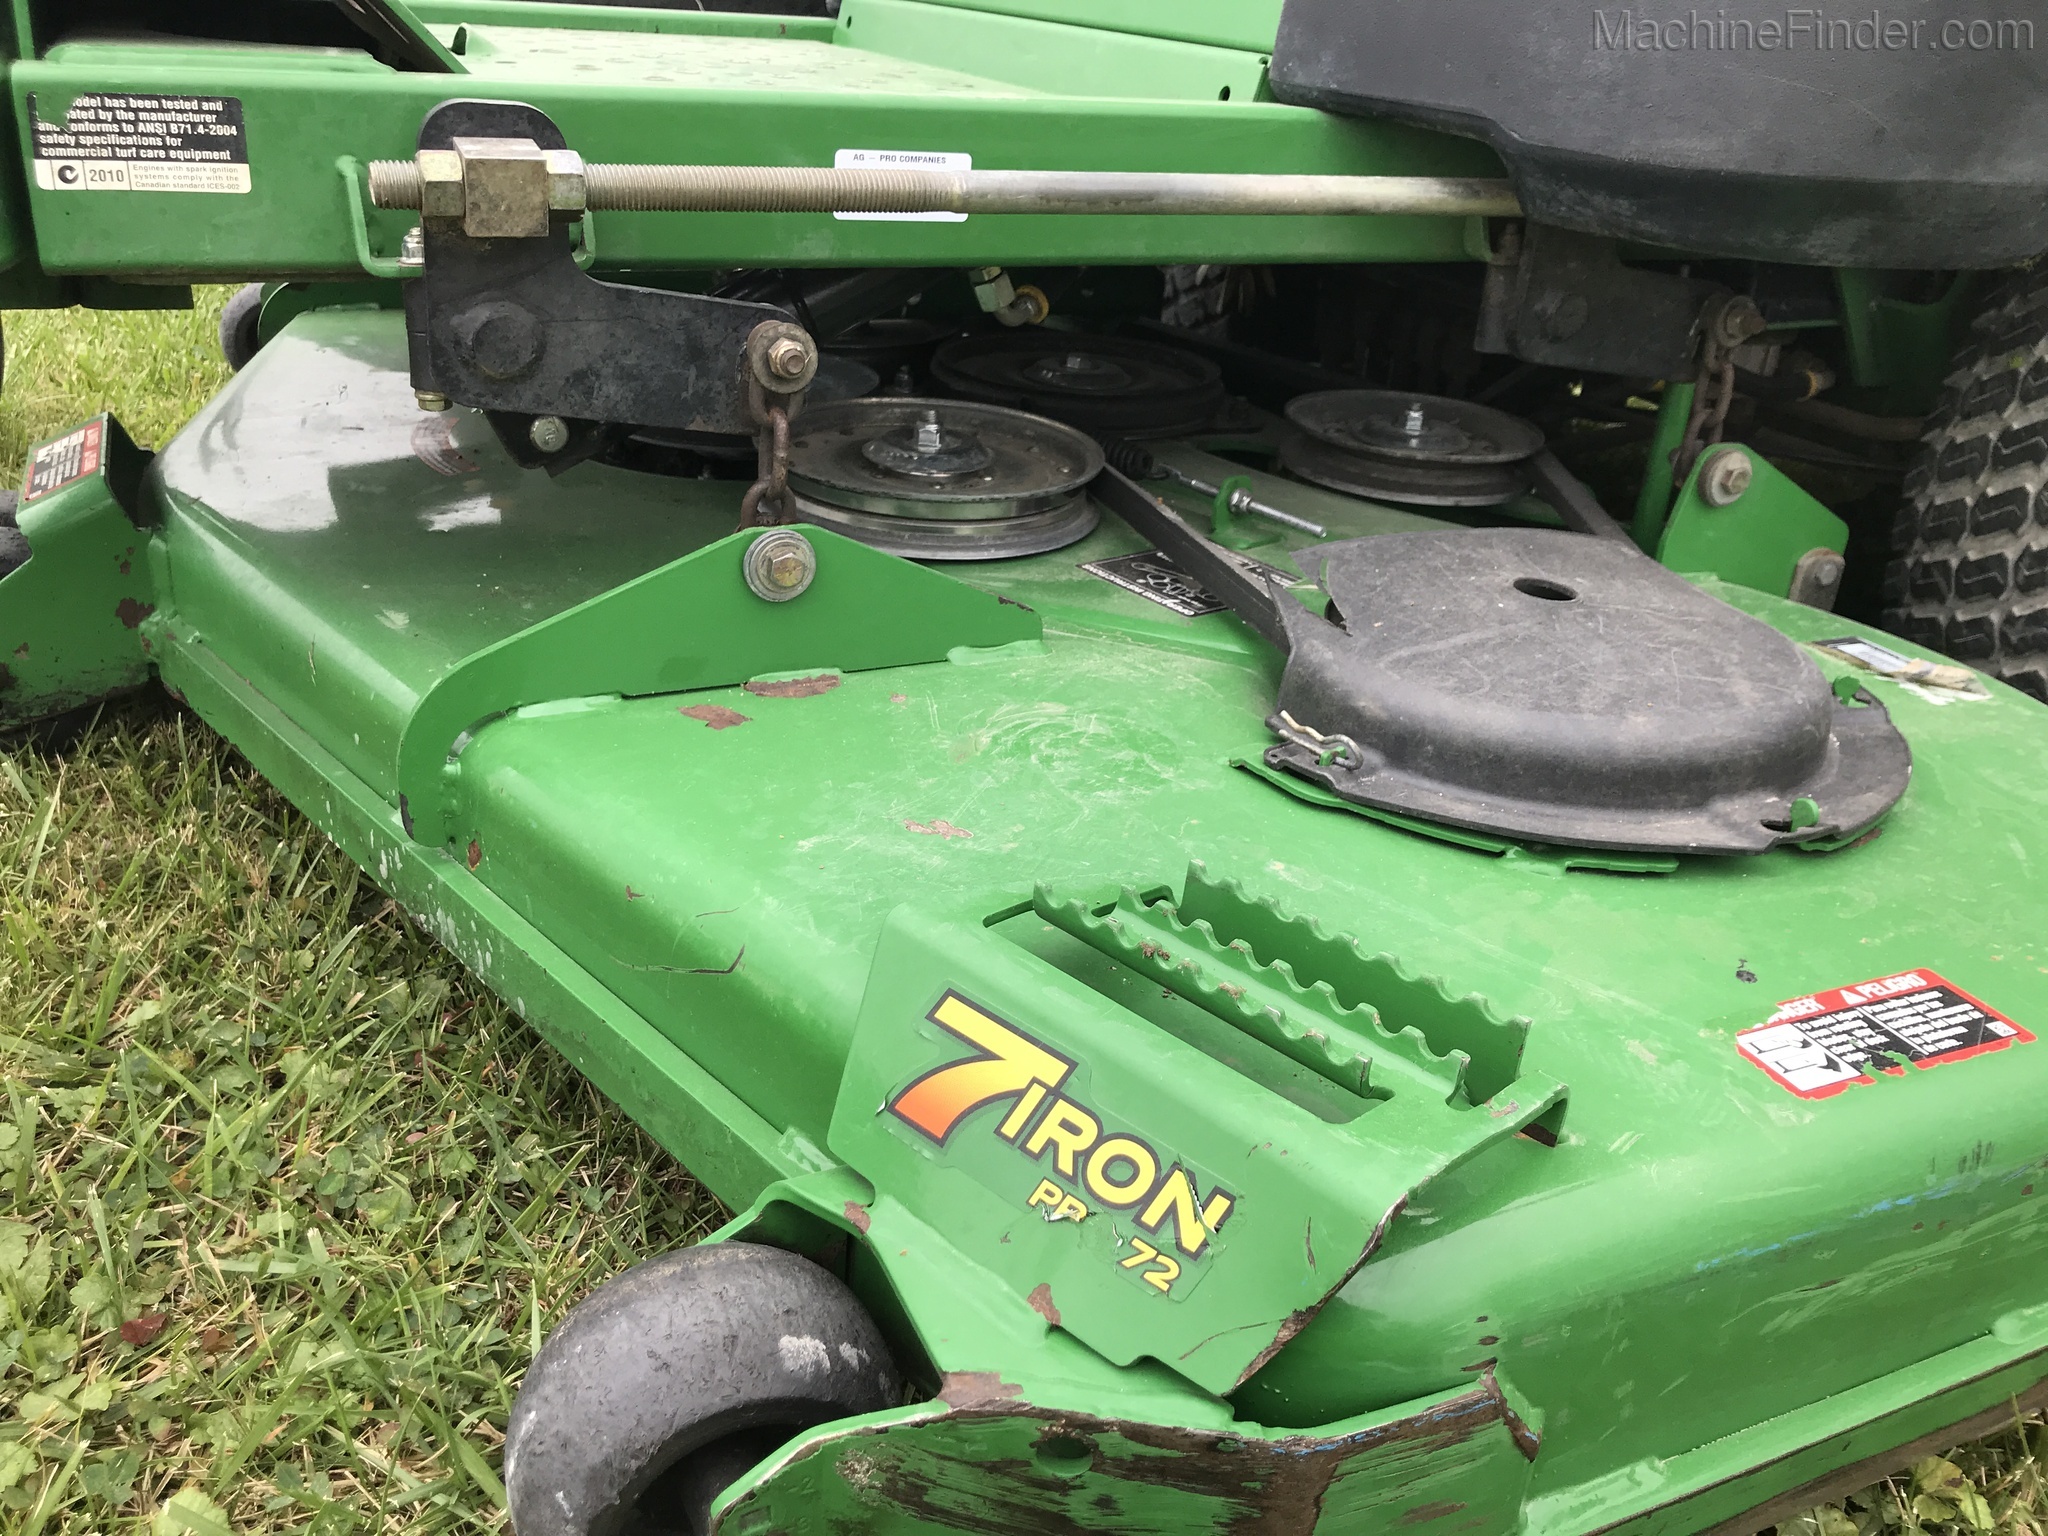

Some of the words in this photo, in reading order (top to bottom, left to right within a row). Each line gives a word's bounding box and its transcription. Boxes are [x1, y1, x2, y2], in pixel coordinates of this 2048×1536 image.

[73, 96, 102, 107] odel
[104, 96, 127, 108] has
[129, 97, 159, 109] been
[161, 98, 199, 110] tested
[201, 100, 224, 111] and
[98, 109, 113, 122] by
[115, 109, 136, 121] the
[138, 110, 218, 123] manufacturer
[69, 121, 120, 132] onforms
[121, 122, 135, 133] to
[138, 122, 167, 134] ANSI
[170, 123, 238, 136] B71.4-2004
[39, 133, 76, 146] safety
[79, 134, 163, 147] specifications
[165, 135, 183, 147] for
[41, 146, 113, 157] commercial
[115, 147, 137, 158] turf
[139, 149, 167, 159] care
[169, 148, 232, 162] equipment
[853, 153, 865, 161] AG
[879, 154, 897, 163] PRO
[899, 155, 947, 165] COMPANIES
[89, 168, 125, 183] 2010
[133, 164, 165, 173] Engines
[186, 165, 208, 173] spark
[209, 166, 239, 174] ignition
[134, 173, 170, 181] systems
[172, 173, 203, 181] comply
[135, 181, 171, 189] Canadian
[172, 182, 206, 190] standard
[1855, 972, 1928, 998] PELIGRO
[887, 988, 1078, 1148] 7
[995, 1078, 1235, 1260] IRON
[1115, 1236, 1181, 1294] 72
